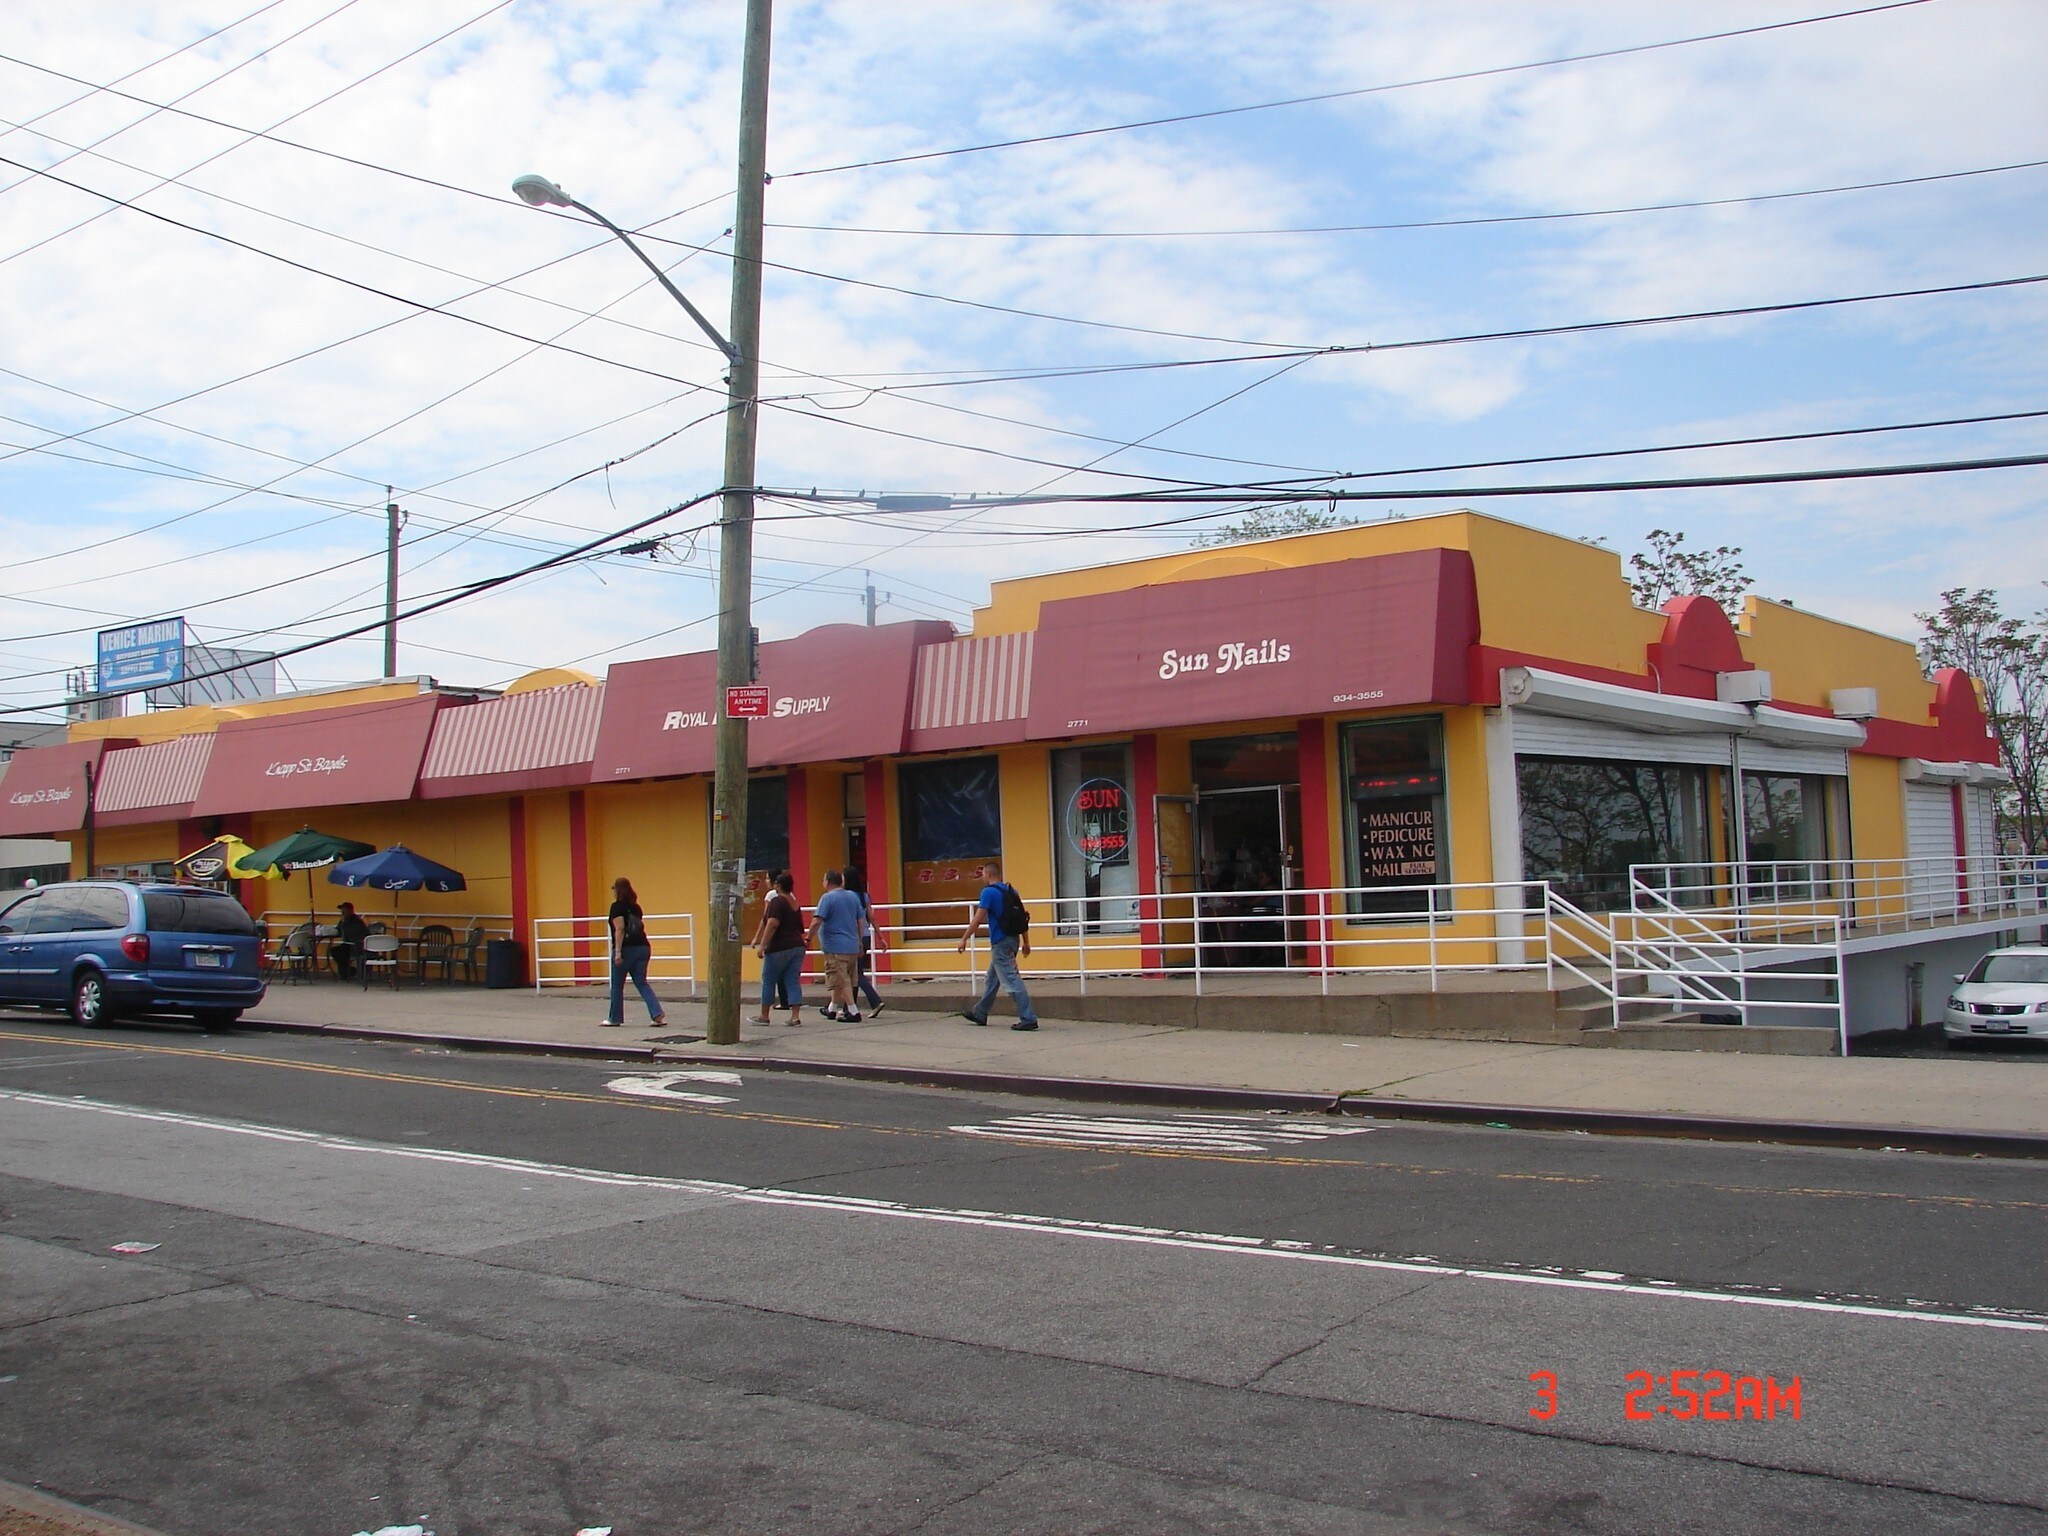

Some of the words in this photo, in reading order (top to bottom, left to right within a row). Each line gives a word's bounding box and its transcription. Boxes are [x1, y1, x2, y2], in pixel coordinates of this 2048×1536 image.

[102, 630, 136, 652] VENICE
[138, 621, 180, 646] MARINA
[1159, 649, 1209, 680] Sun
[1215, 638, 1291, 674] Nails
[740, 689, 767, 697] STANDING
[1333, 690, 1384, 703] 934-3555
[662, 711, 708, 731] ROYAL
[772, 696, 831, 718] SUPPLY
[1067, 720, 1088, 728] 2771
[1078, 788, 1120, 810] SUN
[1370, 827, 1434, 844] PEDICURE
[292, 855, 334, 870] Heineken
